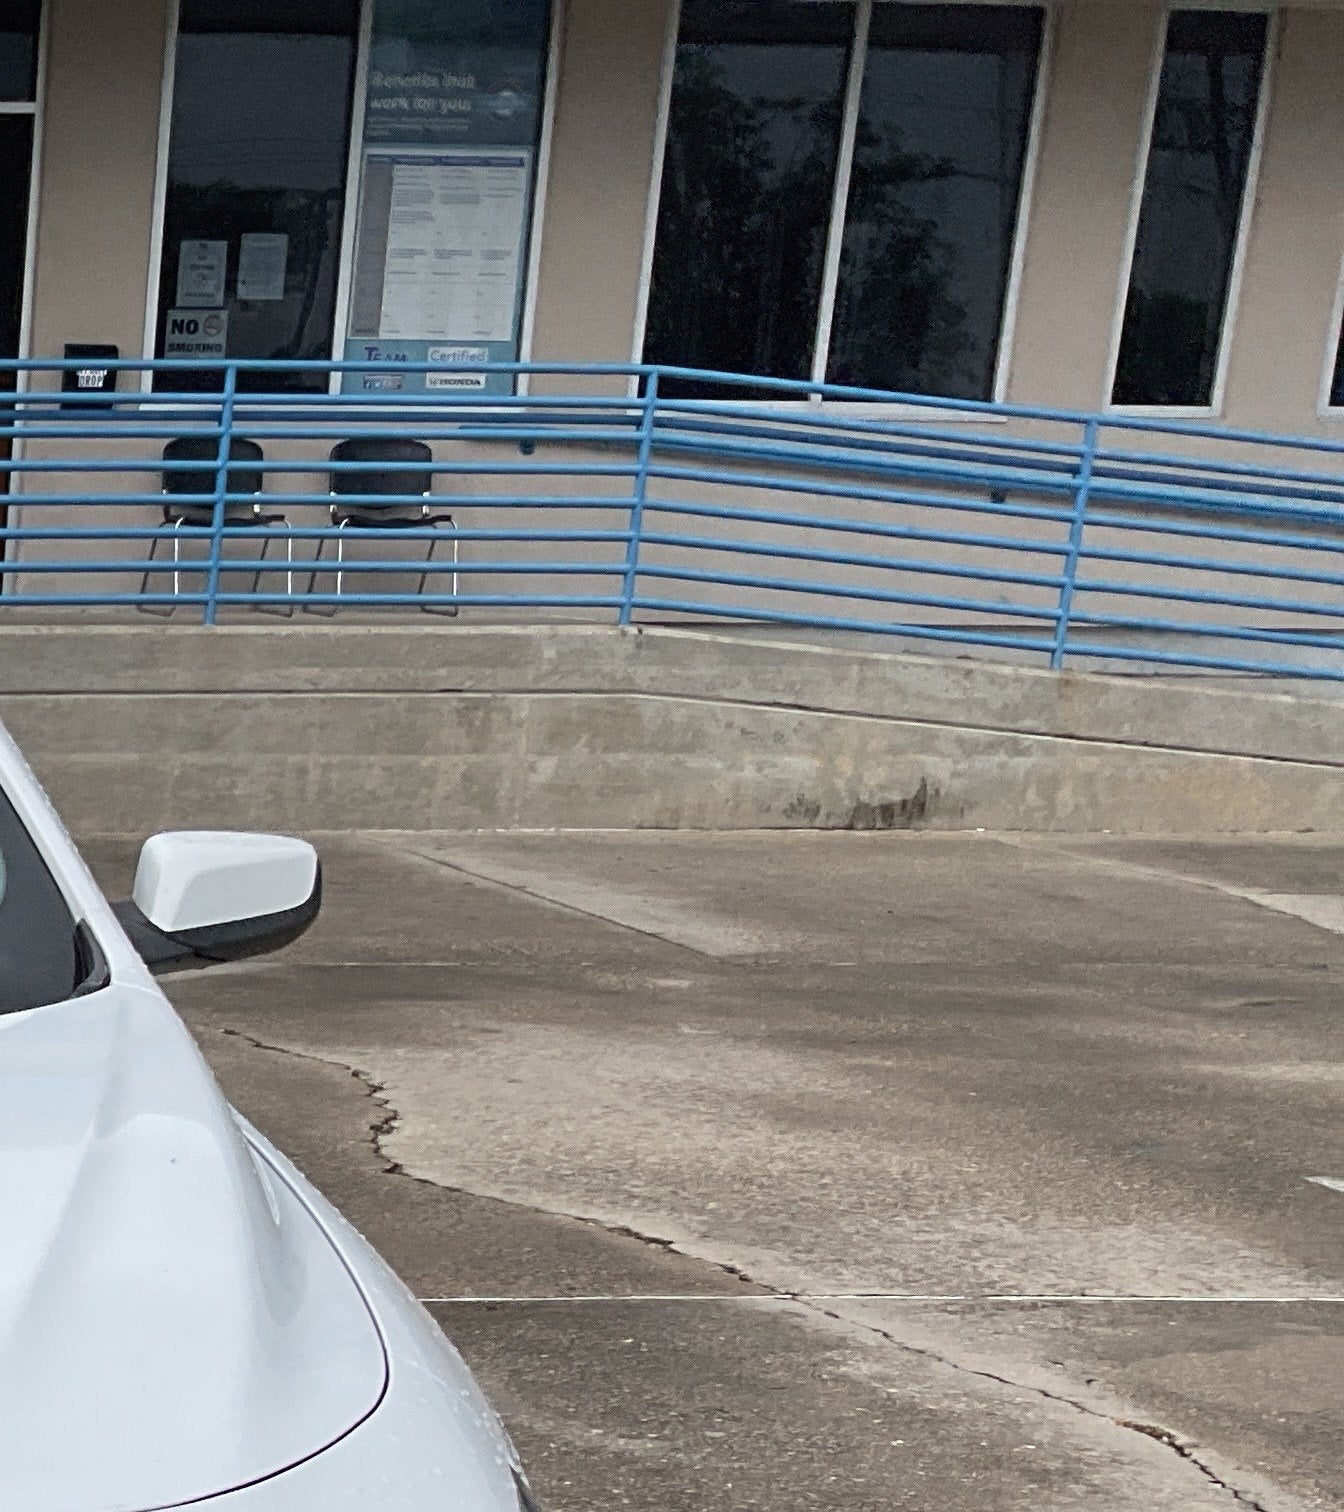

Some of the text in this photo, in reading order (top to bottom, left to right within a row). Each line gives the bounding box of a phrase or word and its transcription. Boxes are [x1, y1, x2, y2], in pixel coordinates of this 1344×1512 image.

[171, 318, 200, 336] NO
[167, 343, 223, 353] SMOKING
[429, 348, 486, 362] Certified
[79, 375, 103, 387] DROP
[439, 378, 481, 386] HONDA
